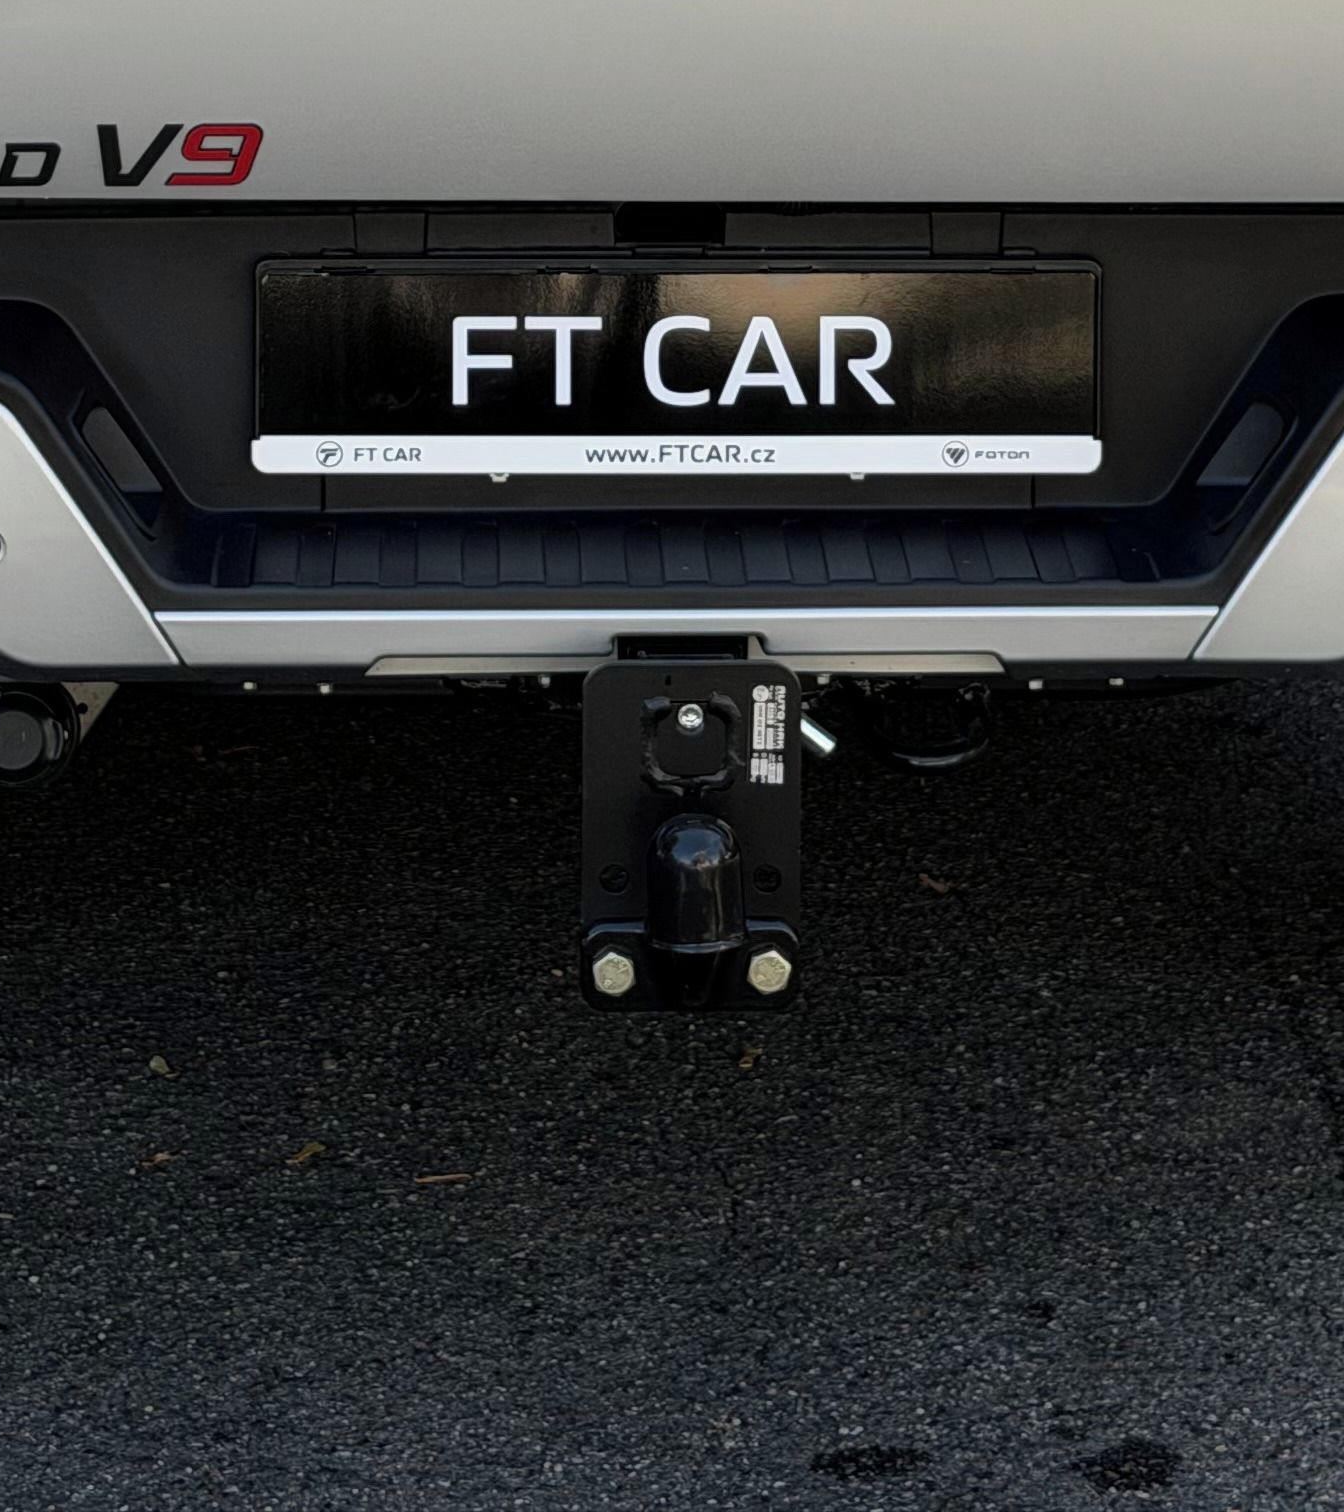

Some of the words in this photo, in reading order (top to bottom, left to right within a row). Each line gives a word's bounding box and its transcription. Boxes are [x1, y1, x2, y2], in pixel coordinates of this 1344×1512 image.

[96, 123, 264, 187] V9
[452, 315, 603, 406] FT
[642, 315, 896, 407] CAR
[354, 447, 377, 462] FT
[383, 447, 422, 462] CAR
[585, 444, 776, 463] www.FTCAR.cz
[975, 450, 1030, 459] FOTON
